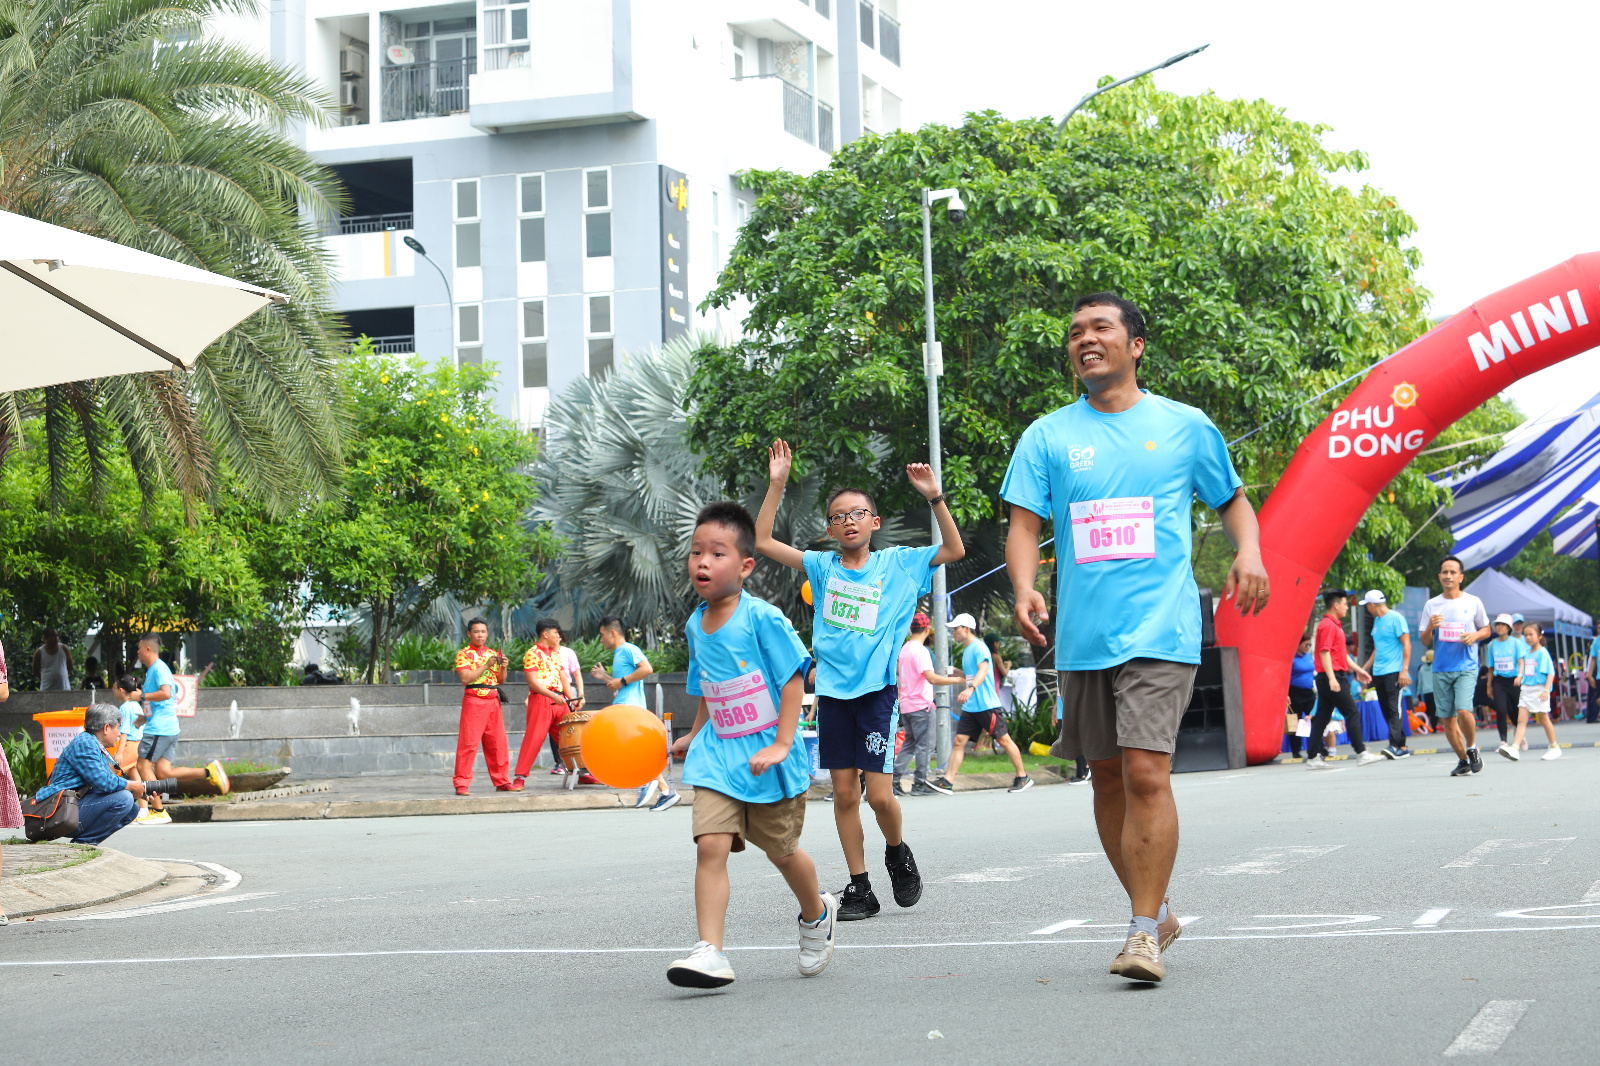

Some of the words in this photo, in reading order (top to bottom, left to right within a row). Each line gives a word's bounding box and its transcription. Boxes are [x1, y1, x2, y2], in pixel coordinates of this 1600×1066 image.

[1467, 288, 1589, 372] MINI
[1330, 404, 1395, 432] PHU
[1068, 447, 1095, 461] GO
[1328, 429, 1424, 459] DONG
[1069, 460, 1094, 469] GREEN
[1089, 525, 1136, 549] 0510
[831, 600, 860, 621] 0371
[714, 702, 759, 728] 0589
